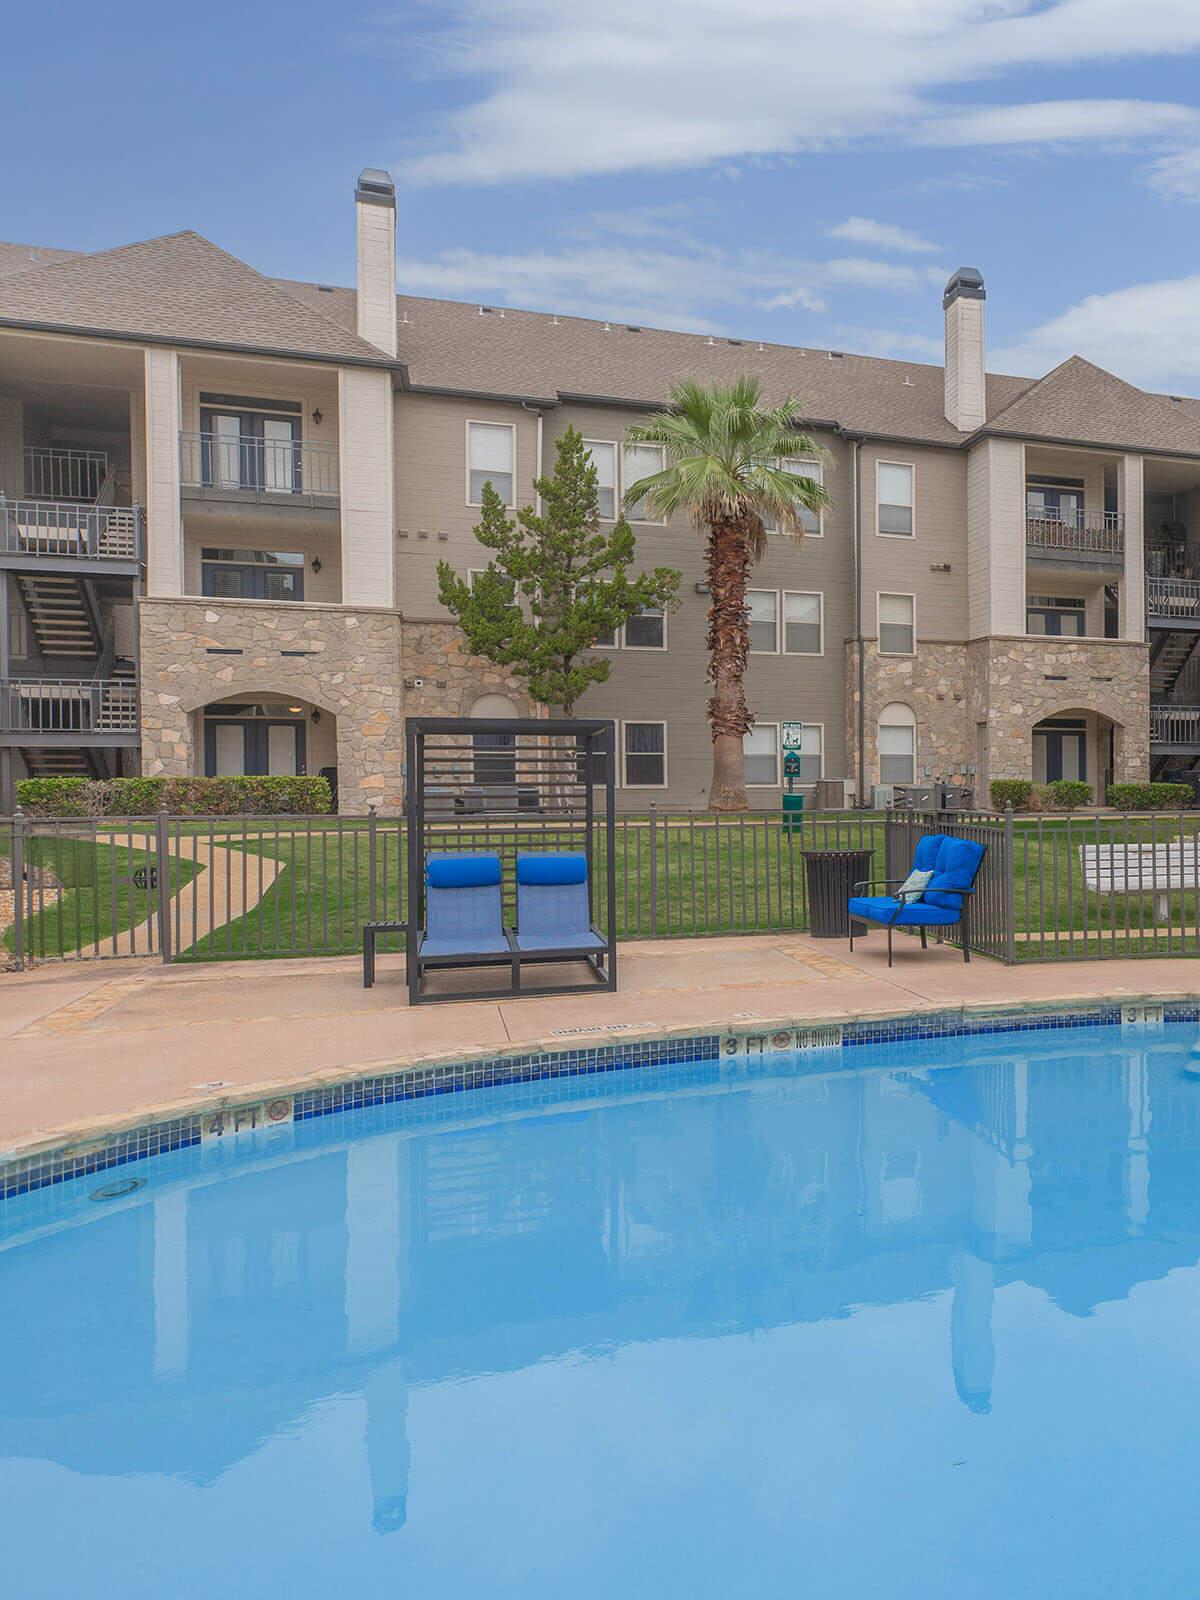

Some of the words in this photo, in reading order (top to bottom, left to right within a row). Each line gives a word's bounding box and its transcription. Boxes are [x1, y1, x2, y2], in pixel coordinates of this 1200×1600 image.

[1128, 1007, 1137, 1022] 3
[1144, 1006, 1162, 1022] FT
[726, 1037, 738, 1055] 3
[746, 1036, 767, 1054] FT
[796, 1031, 808, 1049] NO
[812, 1028, 840, 1048] DIVING
[208, 1111, 225, 1136] 4
[233, 1105, 260, 1132] FT
